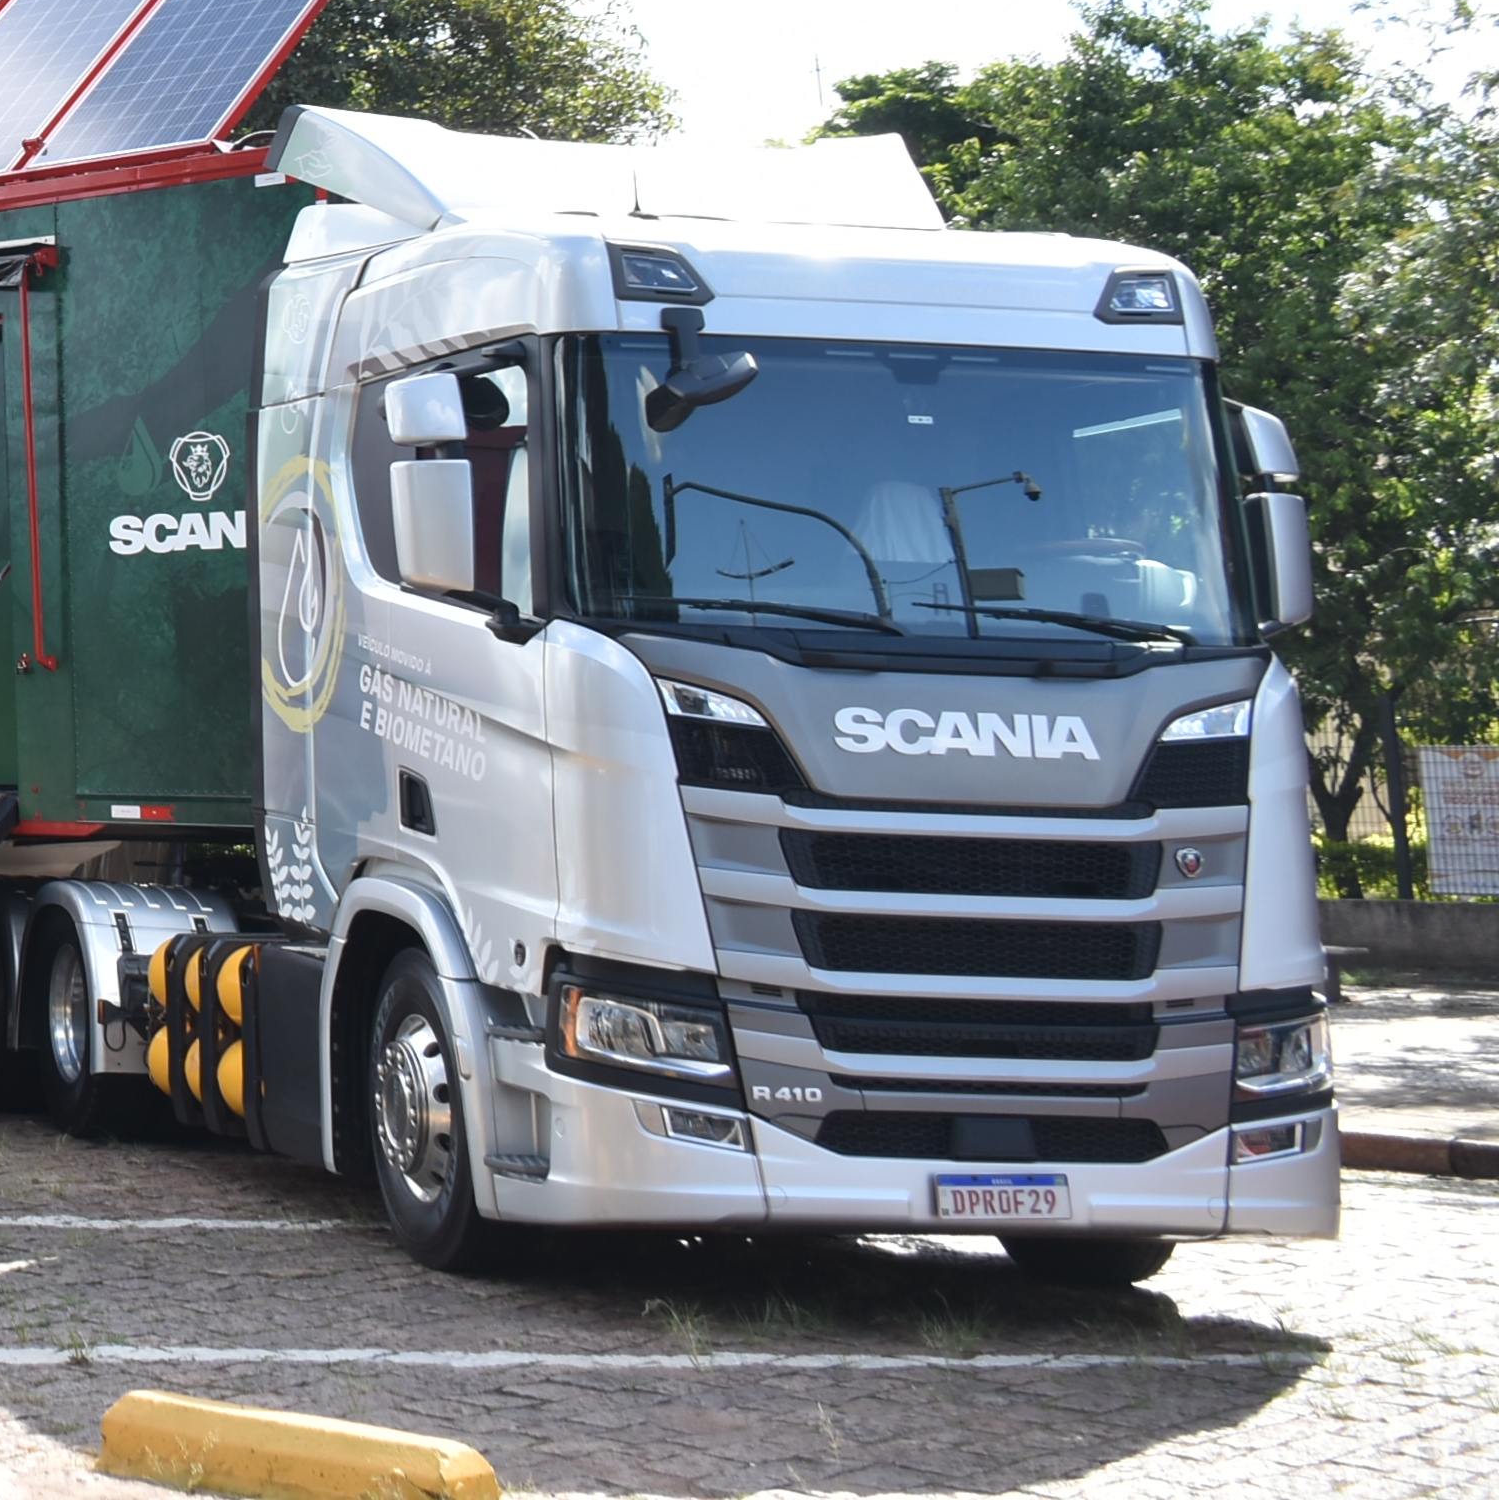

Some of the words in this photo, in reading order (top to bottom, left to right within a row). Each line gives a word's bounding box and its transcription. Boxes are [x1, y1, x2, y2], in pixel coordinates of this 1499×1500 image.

[109, 510, 247, 555] SCAN
[358, 633, 390, 657] VEÍCULO
[391, 649, 423, 673] MOVIDO
[359, 663, 394, 703] GÁS
[398, 680, 486, 744] NATURAL
[359, 700, 373, 731] E
[374, 707, 486, 781] BIOMETANO
[835, 707, 1101, 760] SCANIA
[752, 1086, 772, 1102] R
[776, 1086, 822, 1102] 410
